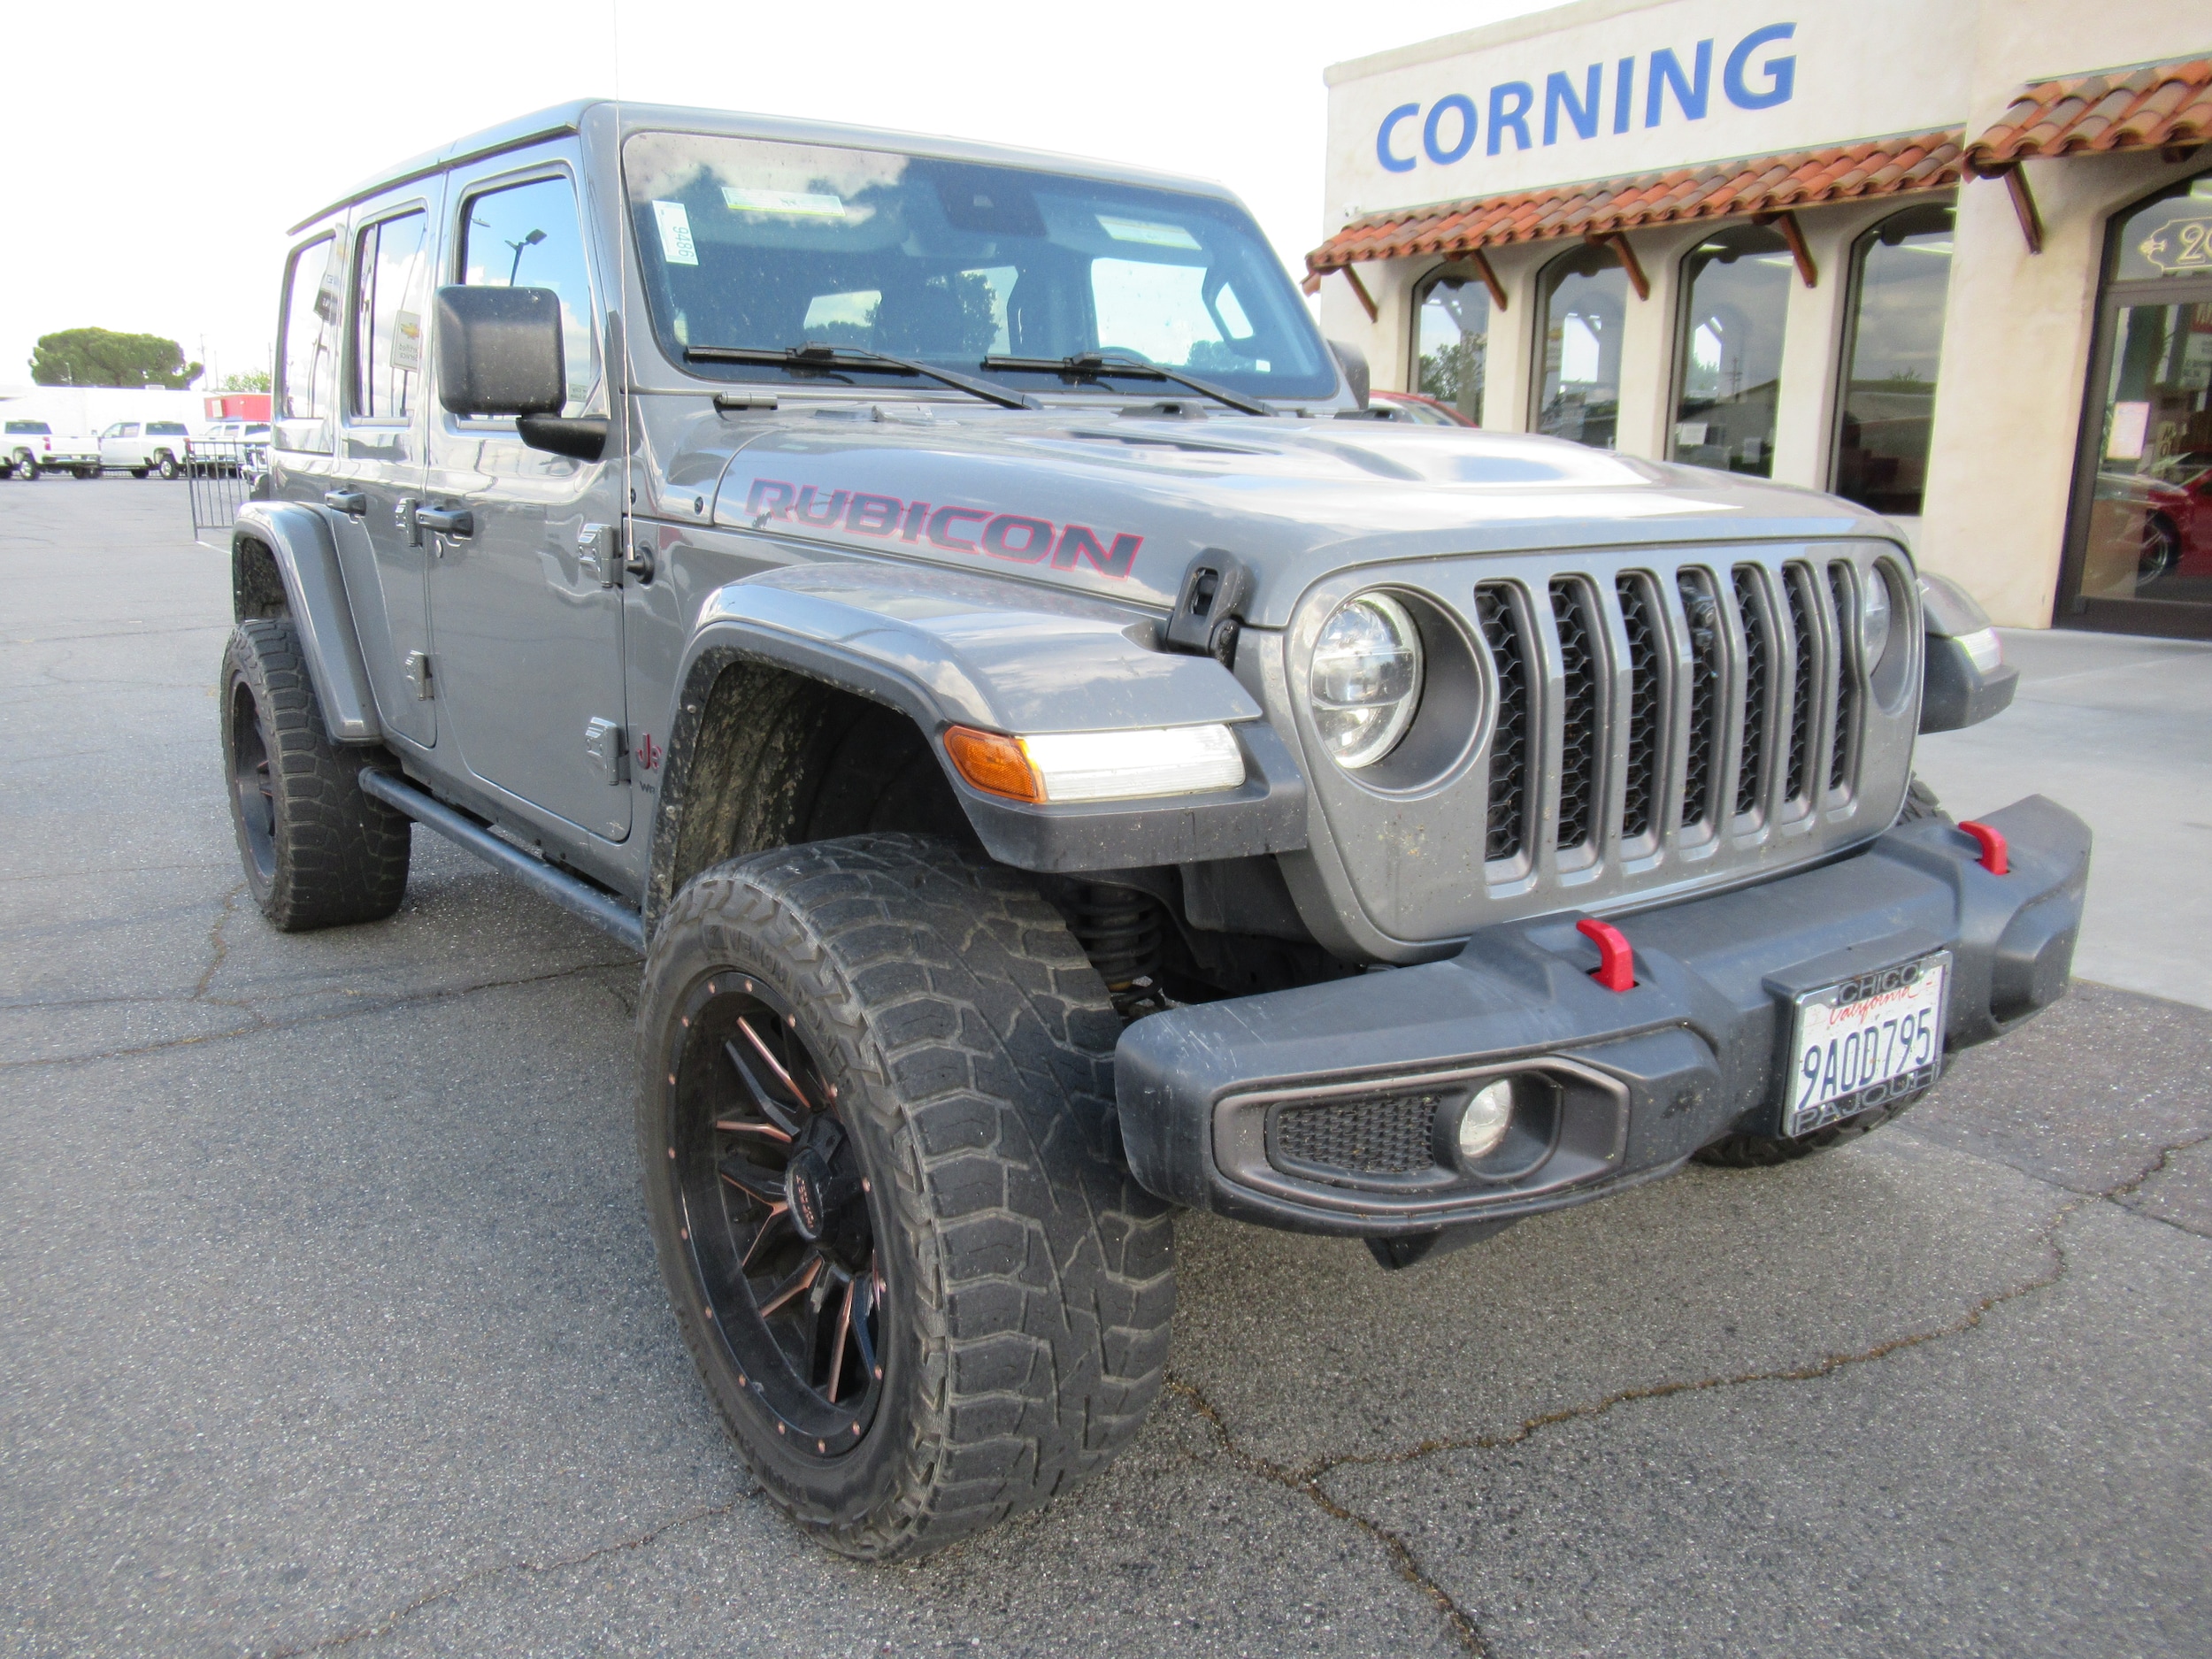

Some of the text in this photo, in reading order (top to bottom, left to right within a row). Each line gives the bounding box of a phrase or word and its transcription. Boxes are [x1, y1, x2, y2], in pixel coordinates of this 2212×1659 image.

[1376, 21, 1797, 173] CORNING
[672, 226, 695, 257] 9486
[744, 478, 1144, 581] RUBICON
[1829, 984, 1918, 1025] California
[1838, 964, 1920, 1004] CHICO
[1795, 1067, 1936, 1134] PAJOUH
